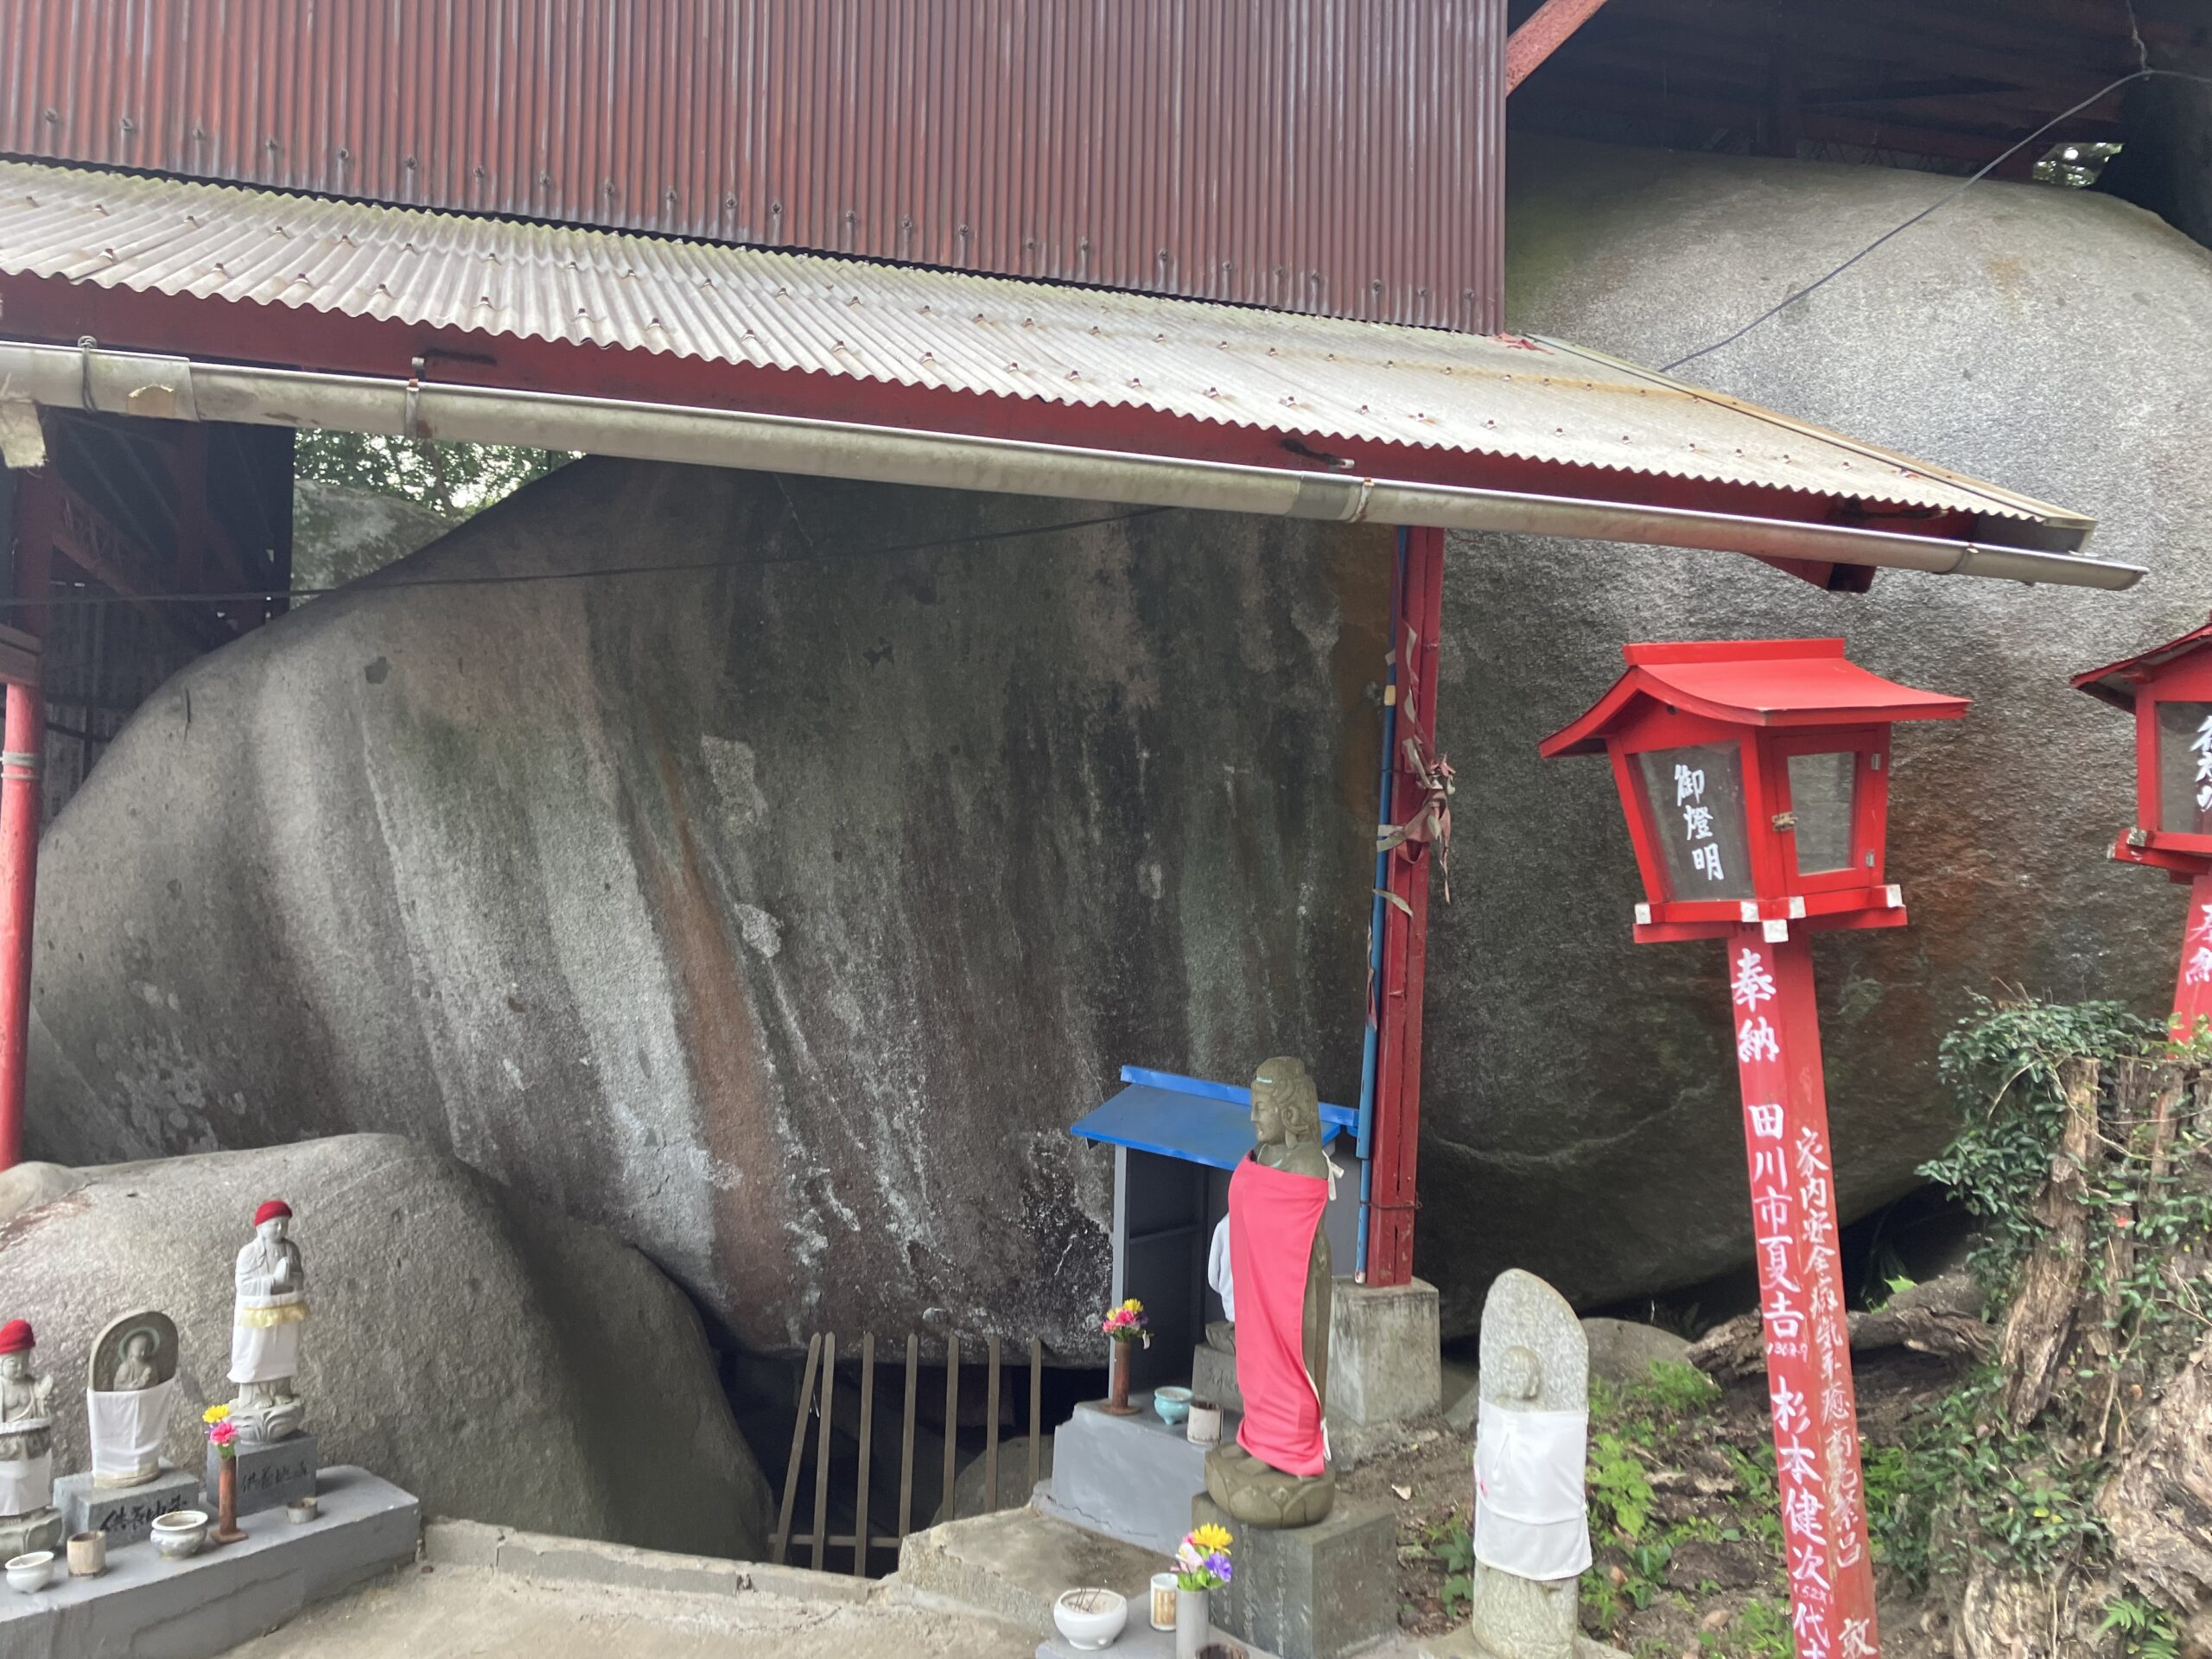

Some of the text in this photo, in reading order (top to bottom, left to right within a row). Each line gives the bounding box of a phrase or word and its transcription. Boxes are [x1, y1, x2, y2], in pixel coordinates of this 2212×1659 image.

[1674, 764, 1726, 881] 御燈明
[1731, 948, 1779, 1063] 奉納
[1748, 1103, 1804, 1338] 田川市夏吉
[1770, 1376, 1831, 1591] 杉本健次
